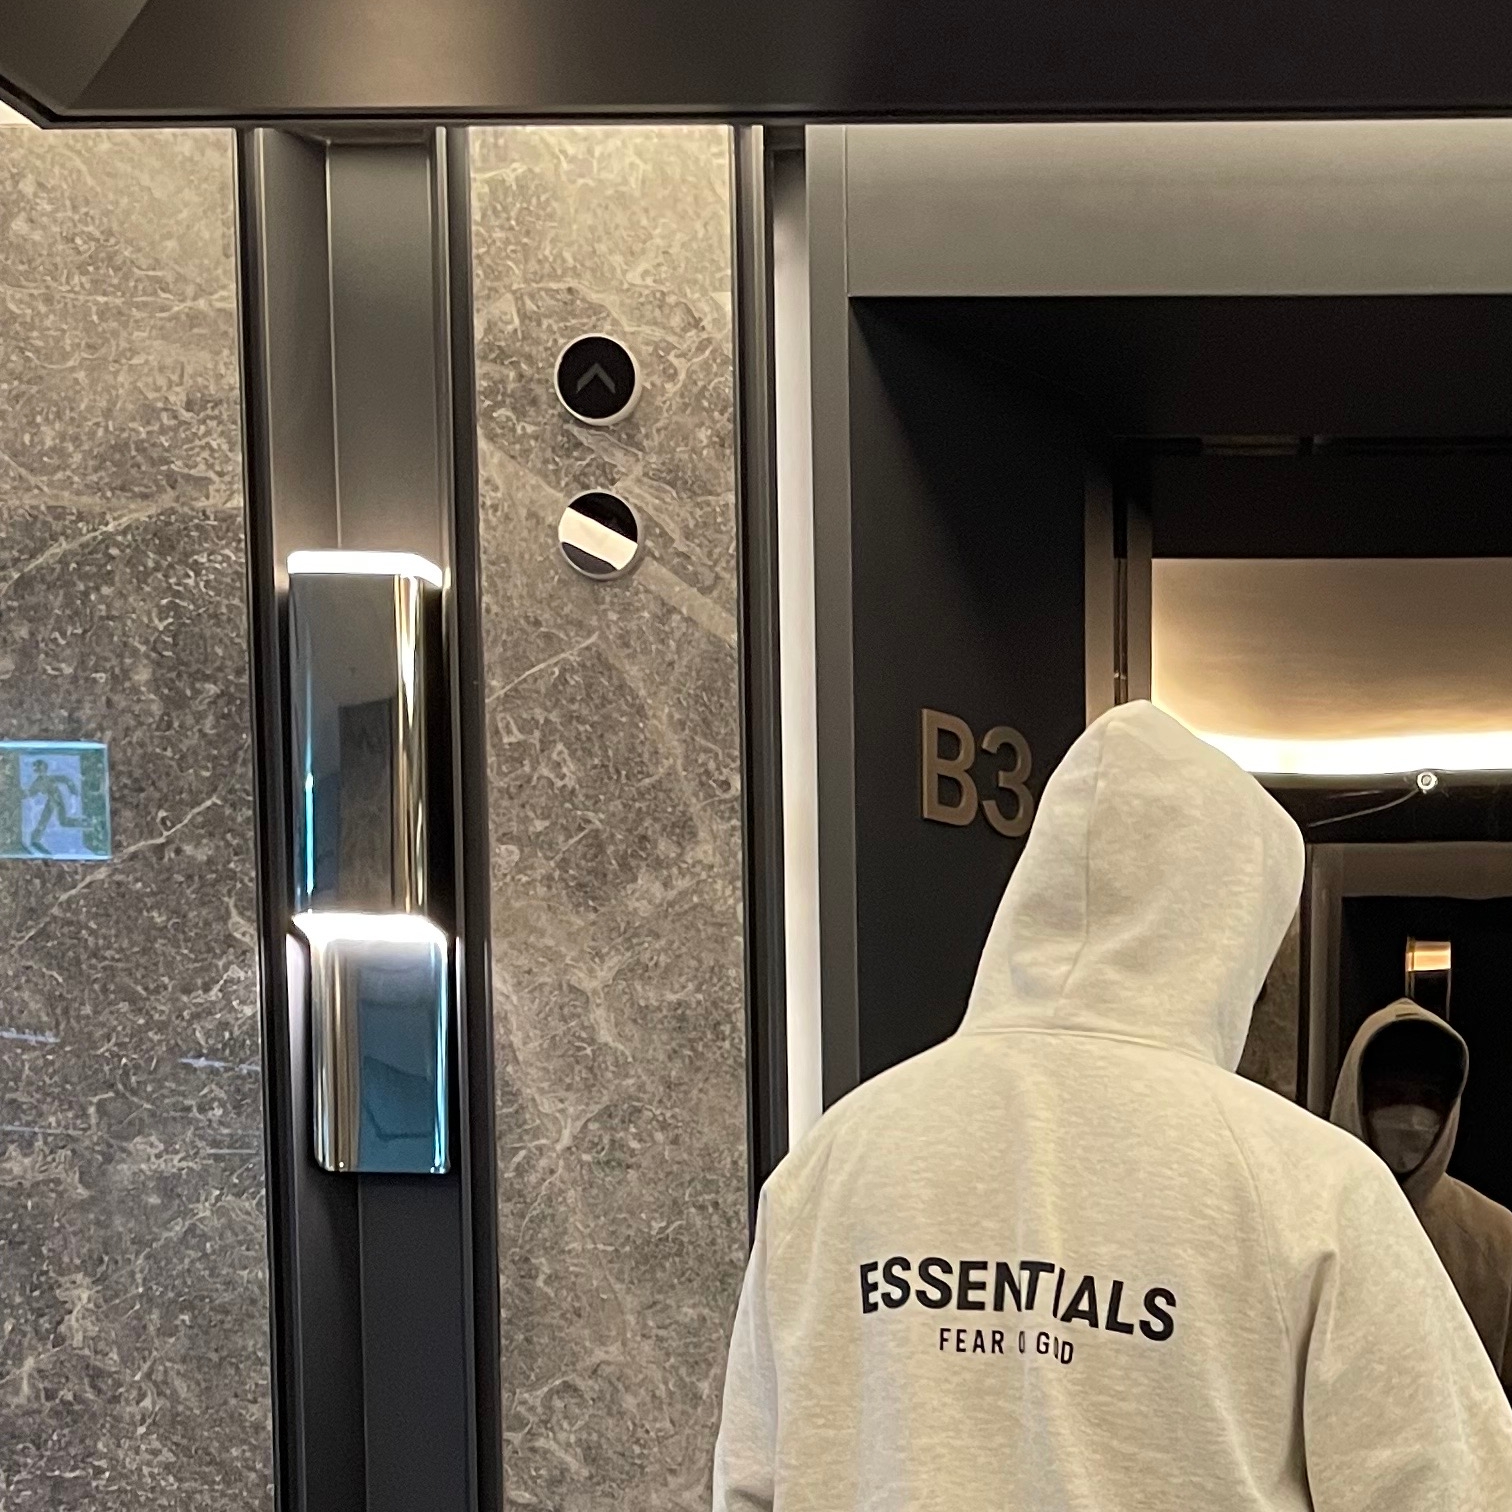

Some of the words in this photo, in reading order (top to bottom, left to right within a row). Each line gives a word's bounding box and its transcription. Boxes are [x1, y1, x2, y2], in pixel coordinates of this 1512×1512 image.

[921, 707, 1034, 837] B3
[860, 1256, 1177, 1342] ESSENTIALS
[939, 1327, 1004, 1354] FEAR
